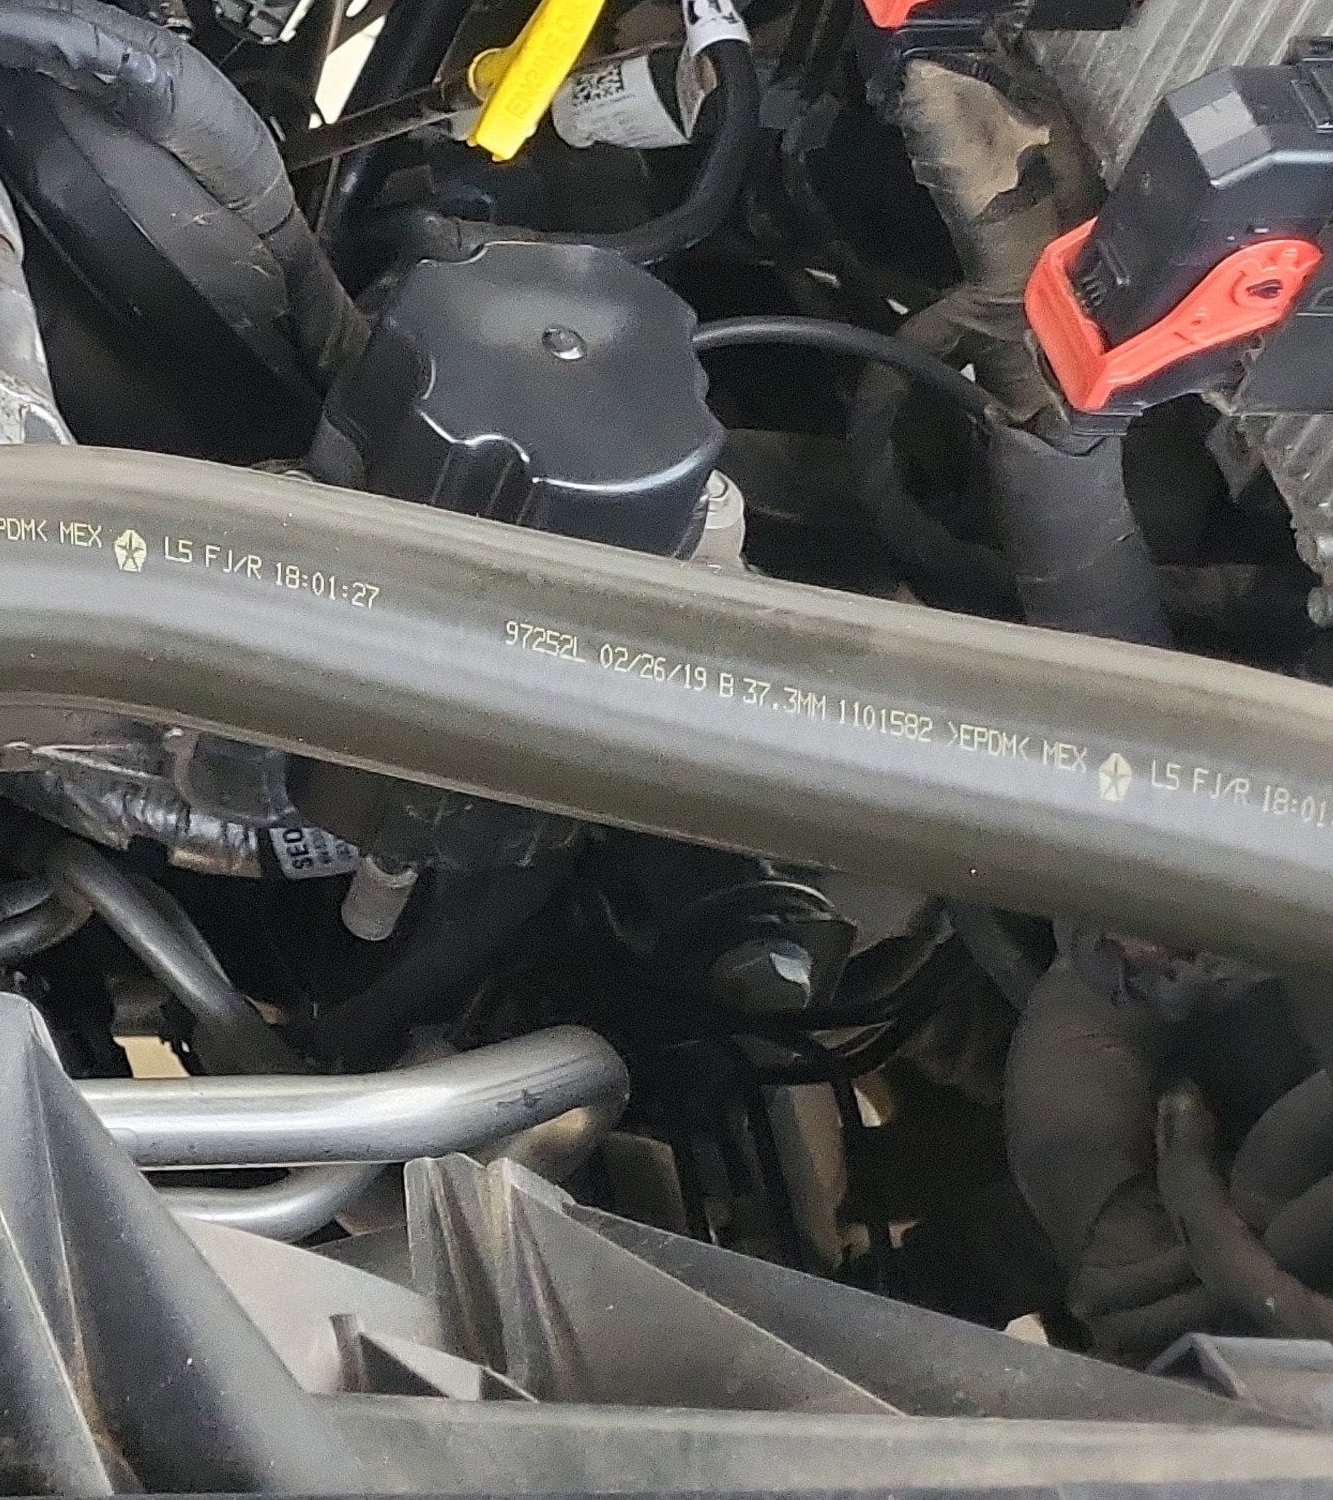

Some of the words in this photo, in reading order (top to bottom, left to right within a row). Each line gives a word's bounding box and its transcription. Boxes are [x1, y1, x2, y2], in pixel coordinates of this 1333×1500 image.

[59, 520, 103, 548] MEX
[274, 561, 380, 610] 18:01:27
[504, 619, 587, 664] 97252L
[599, 642, 708, 692] 02/26/19
[719, 672, 734, 698] B
[742, 677, 827, 721] 37.3MM
[837, 698, 934, 744] 1101582
[1042, 739, 1089, 775] MEX
[1262, 783, 1333, 829] 18:01:
